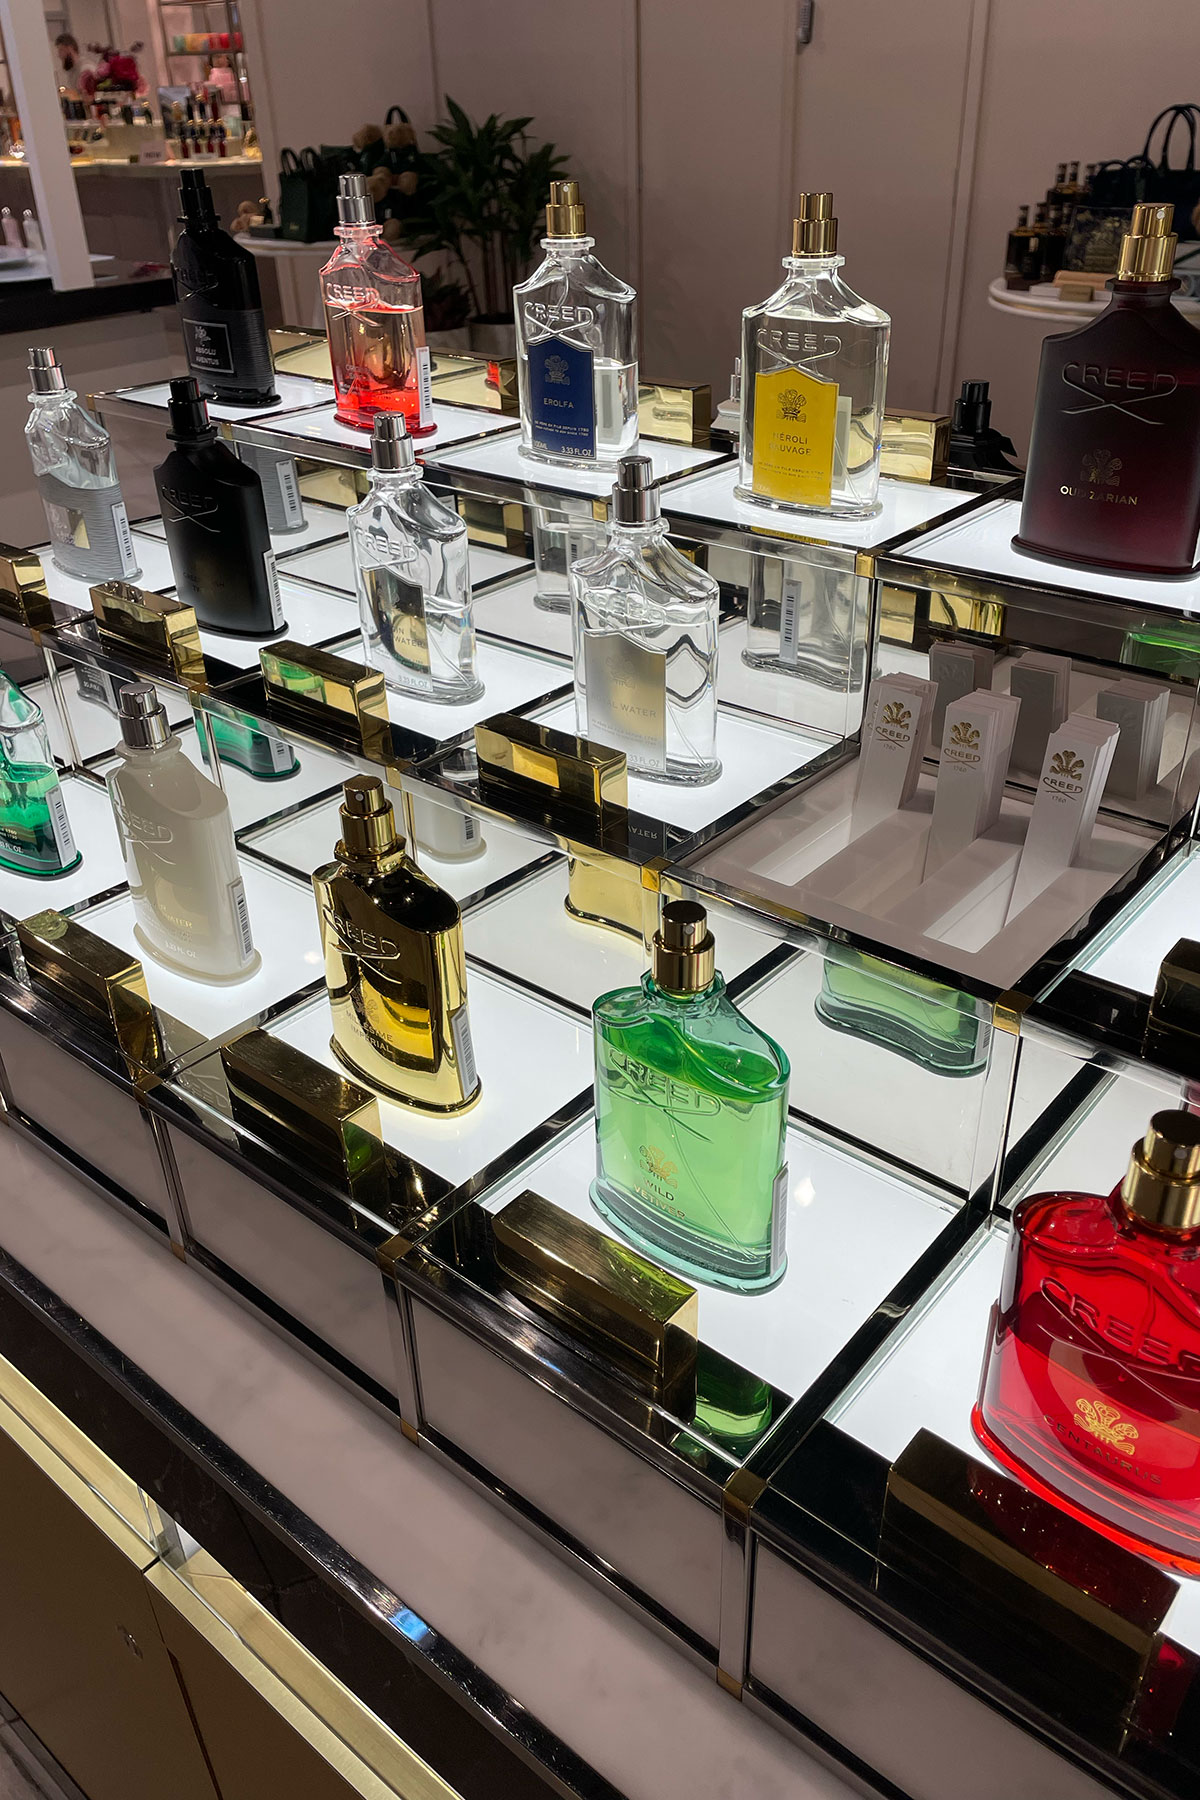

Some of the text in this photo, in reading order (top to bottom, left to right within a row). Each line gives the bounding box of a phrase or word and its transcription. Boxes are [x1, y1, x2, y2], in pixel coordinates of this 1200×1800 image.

[326, 283, 380, 310] CREED
[524, 302, 594, 332] CREED
[757, 328, 842, 363] CREED
[1061, 362, 1178, 402] CREED
[543, 397, 574, 409] EROLFA
[1060, 485, 1138, 505] OUD ZARIAN
[356, 530, 418, 564] CREED
[620, 702, 658, 718] WATER
[875, 726, 910, 743] CREED
[943, 748, 981, 763] CREED
[1042, 776, 1084, 794] CREED
[113, 800, 174, 842] CREED
[323, 906, 400, 958] CREED
[609, 1047, 720, 1115] CREED
[633, 1183, 686, 1220] VETIVER
[643, 1179, 675, 1202] WILD
[1043, 1414, 1162, 1485] CENTAURUS
